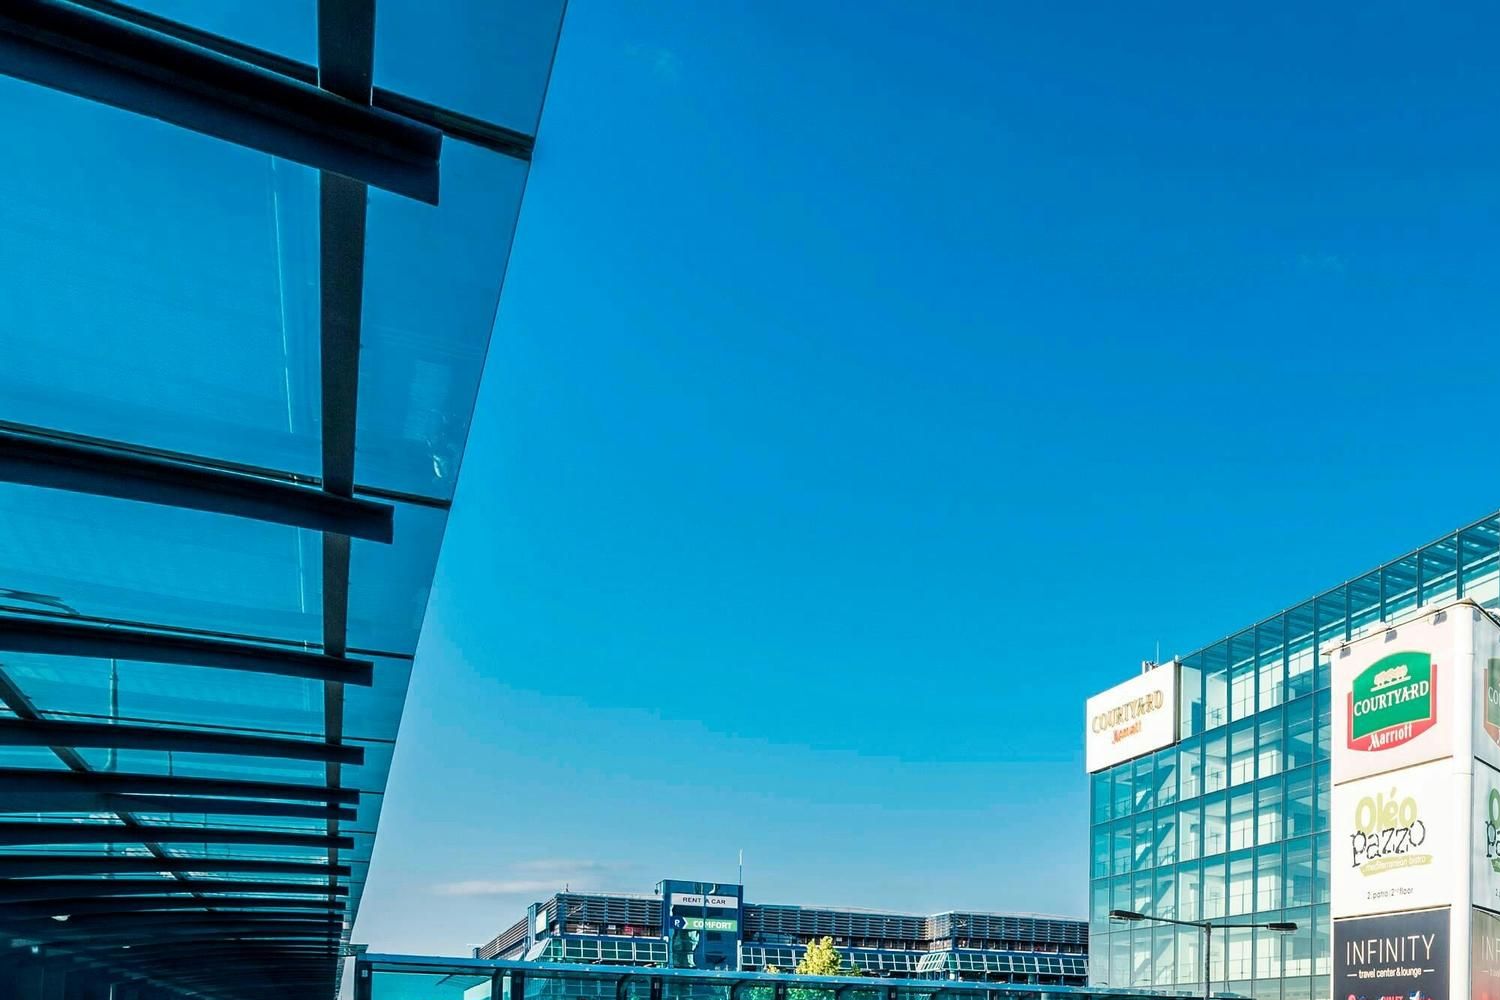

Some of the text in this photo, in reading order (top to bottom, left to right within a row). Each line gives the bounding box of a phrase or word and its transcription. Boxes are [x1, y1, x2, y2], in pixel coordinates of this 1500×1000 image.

[1092, 690, 1164, 734] COURTYARD
[1354, 680, 1430, 717] COURTYARD
[1368, 723, 1412, 751] Marriott
[693, 920, 732, 929] COMFORT
[1346, 934, 1435, 966] INFINITY
[1359, 968, 1376, 979] travel
